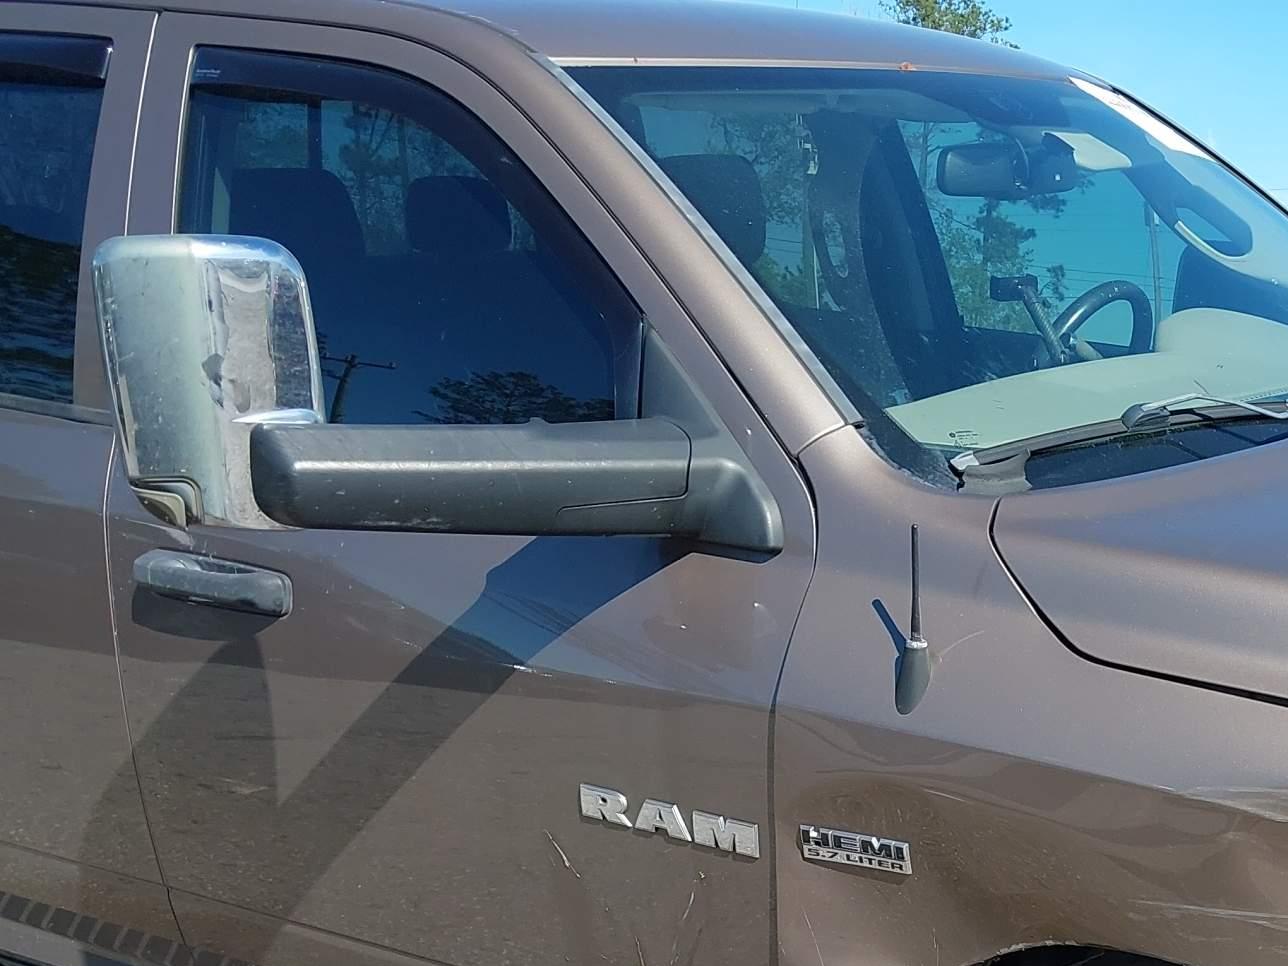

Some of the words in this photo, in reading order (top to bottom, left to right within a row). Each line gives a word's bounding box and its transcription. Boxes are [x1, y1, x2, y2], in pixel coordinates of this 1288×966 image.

[579, 783, 760, 859] RAM
[800, 825, 910, 861] HEMI
[807, 847, 839, 859] 5.7
[846, 853, 904, 871] LITER
